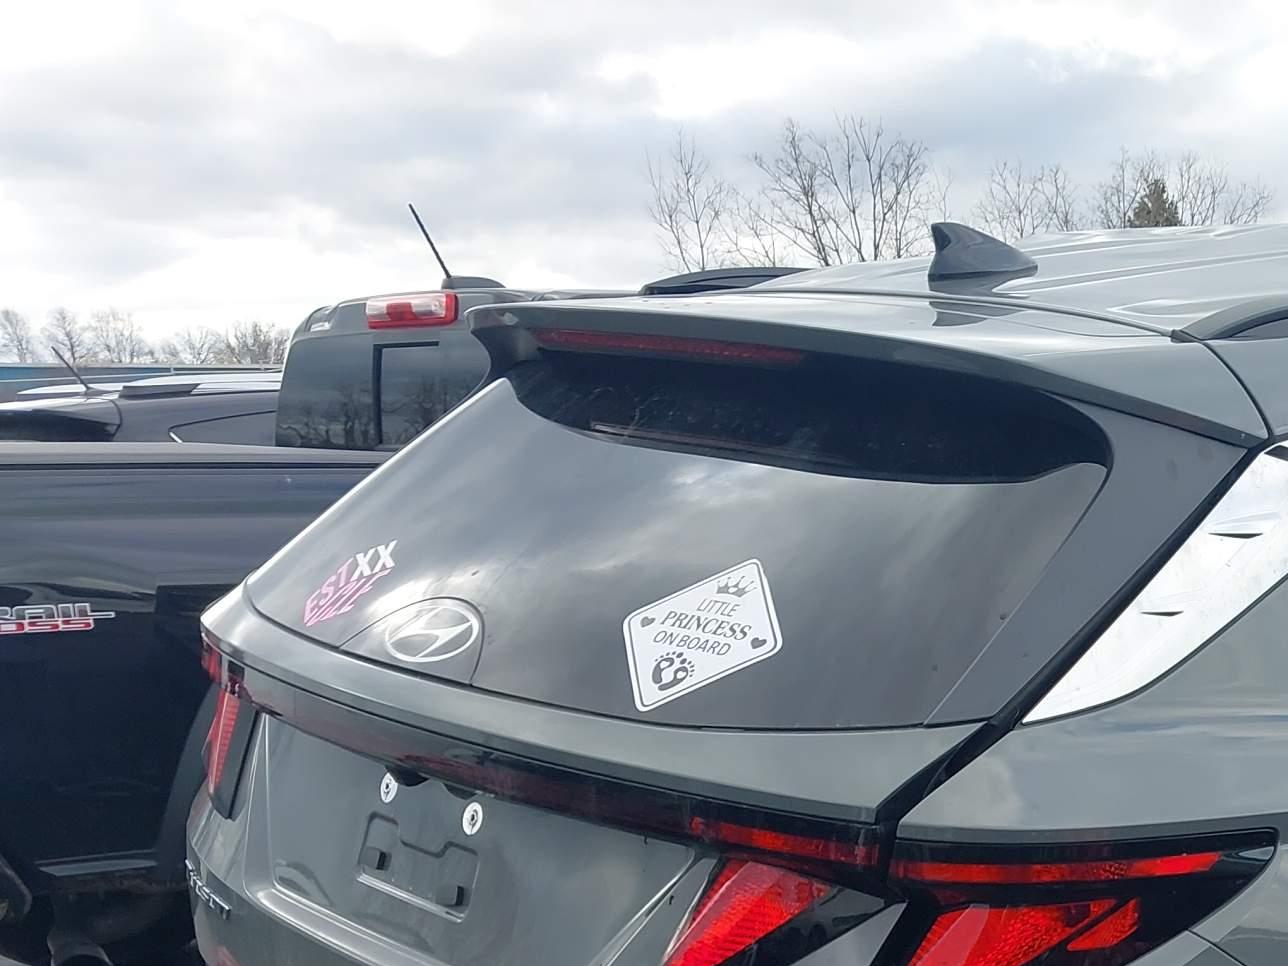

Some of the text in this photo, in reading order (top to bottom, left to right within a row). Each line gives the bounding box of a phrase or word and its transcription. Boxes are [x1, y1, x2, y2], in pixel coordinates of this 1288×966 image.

[697, 598, 741, 617] LITTLE
[660, 611, 752, 641] PRINCESS
[653, 630, 732, 656] ON BOARD
